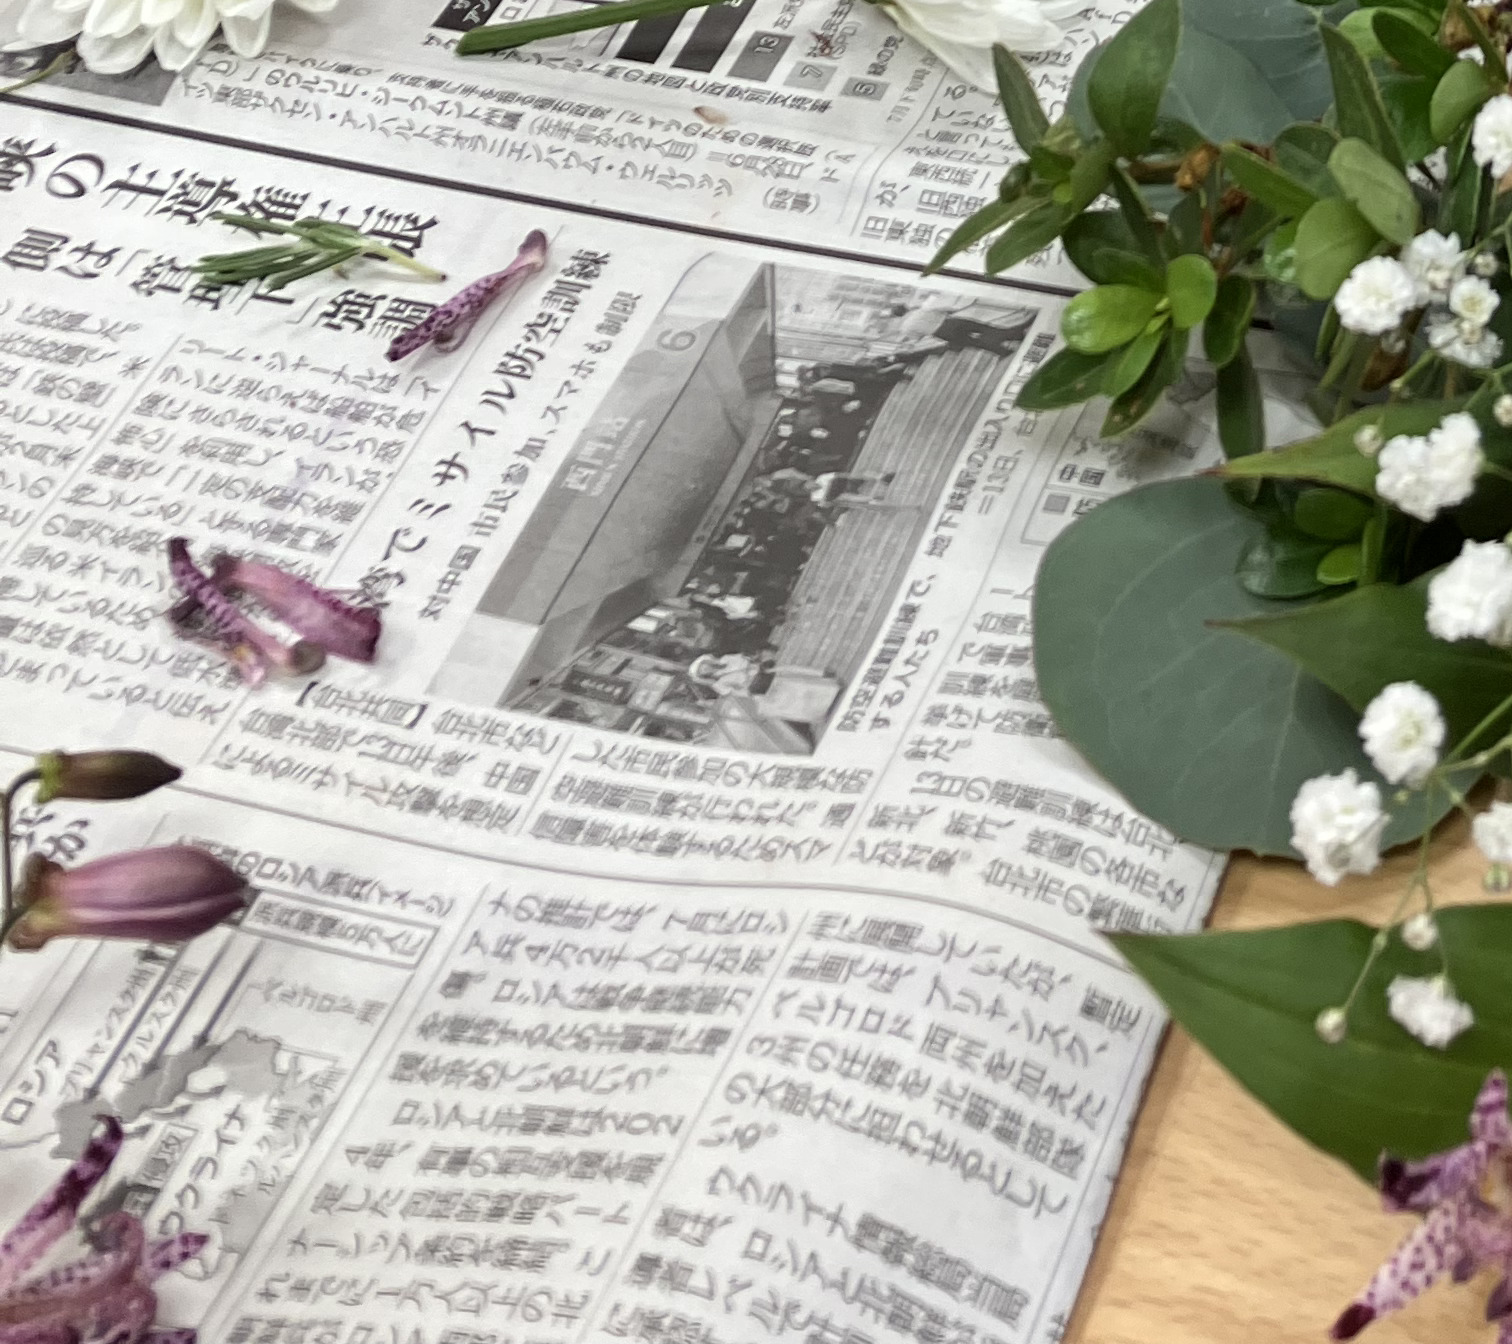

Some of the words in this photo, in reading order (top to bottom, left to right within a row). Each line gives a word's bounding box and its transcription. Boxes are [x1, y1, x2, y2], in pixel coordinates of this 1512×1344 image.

[752, 34, 782, 55] 13
[649, 328, 699, 352] 6
[418, 544, 482, 622] 対中国
[0, 1039, 63, 1126] ロシア
